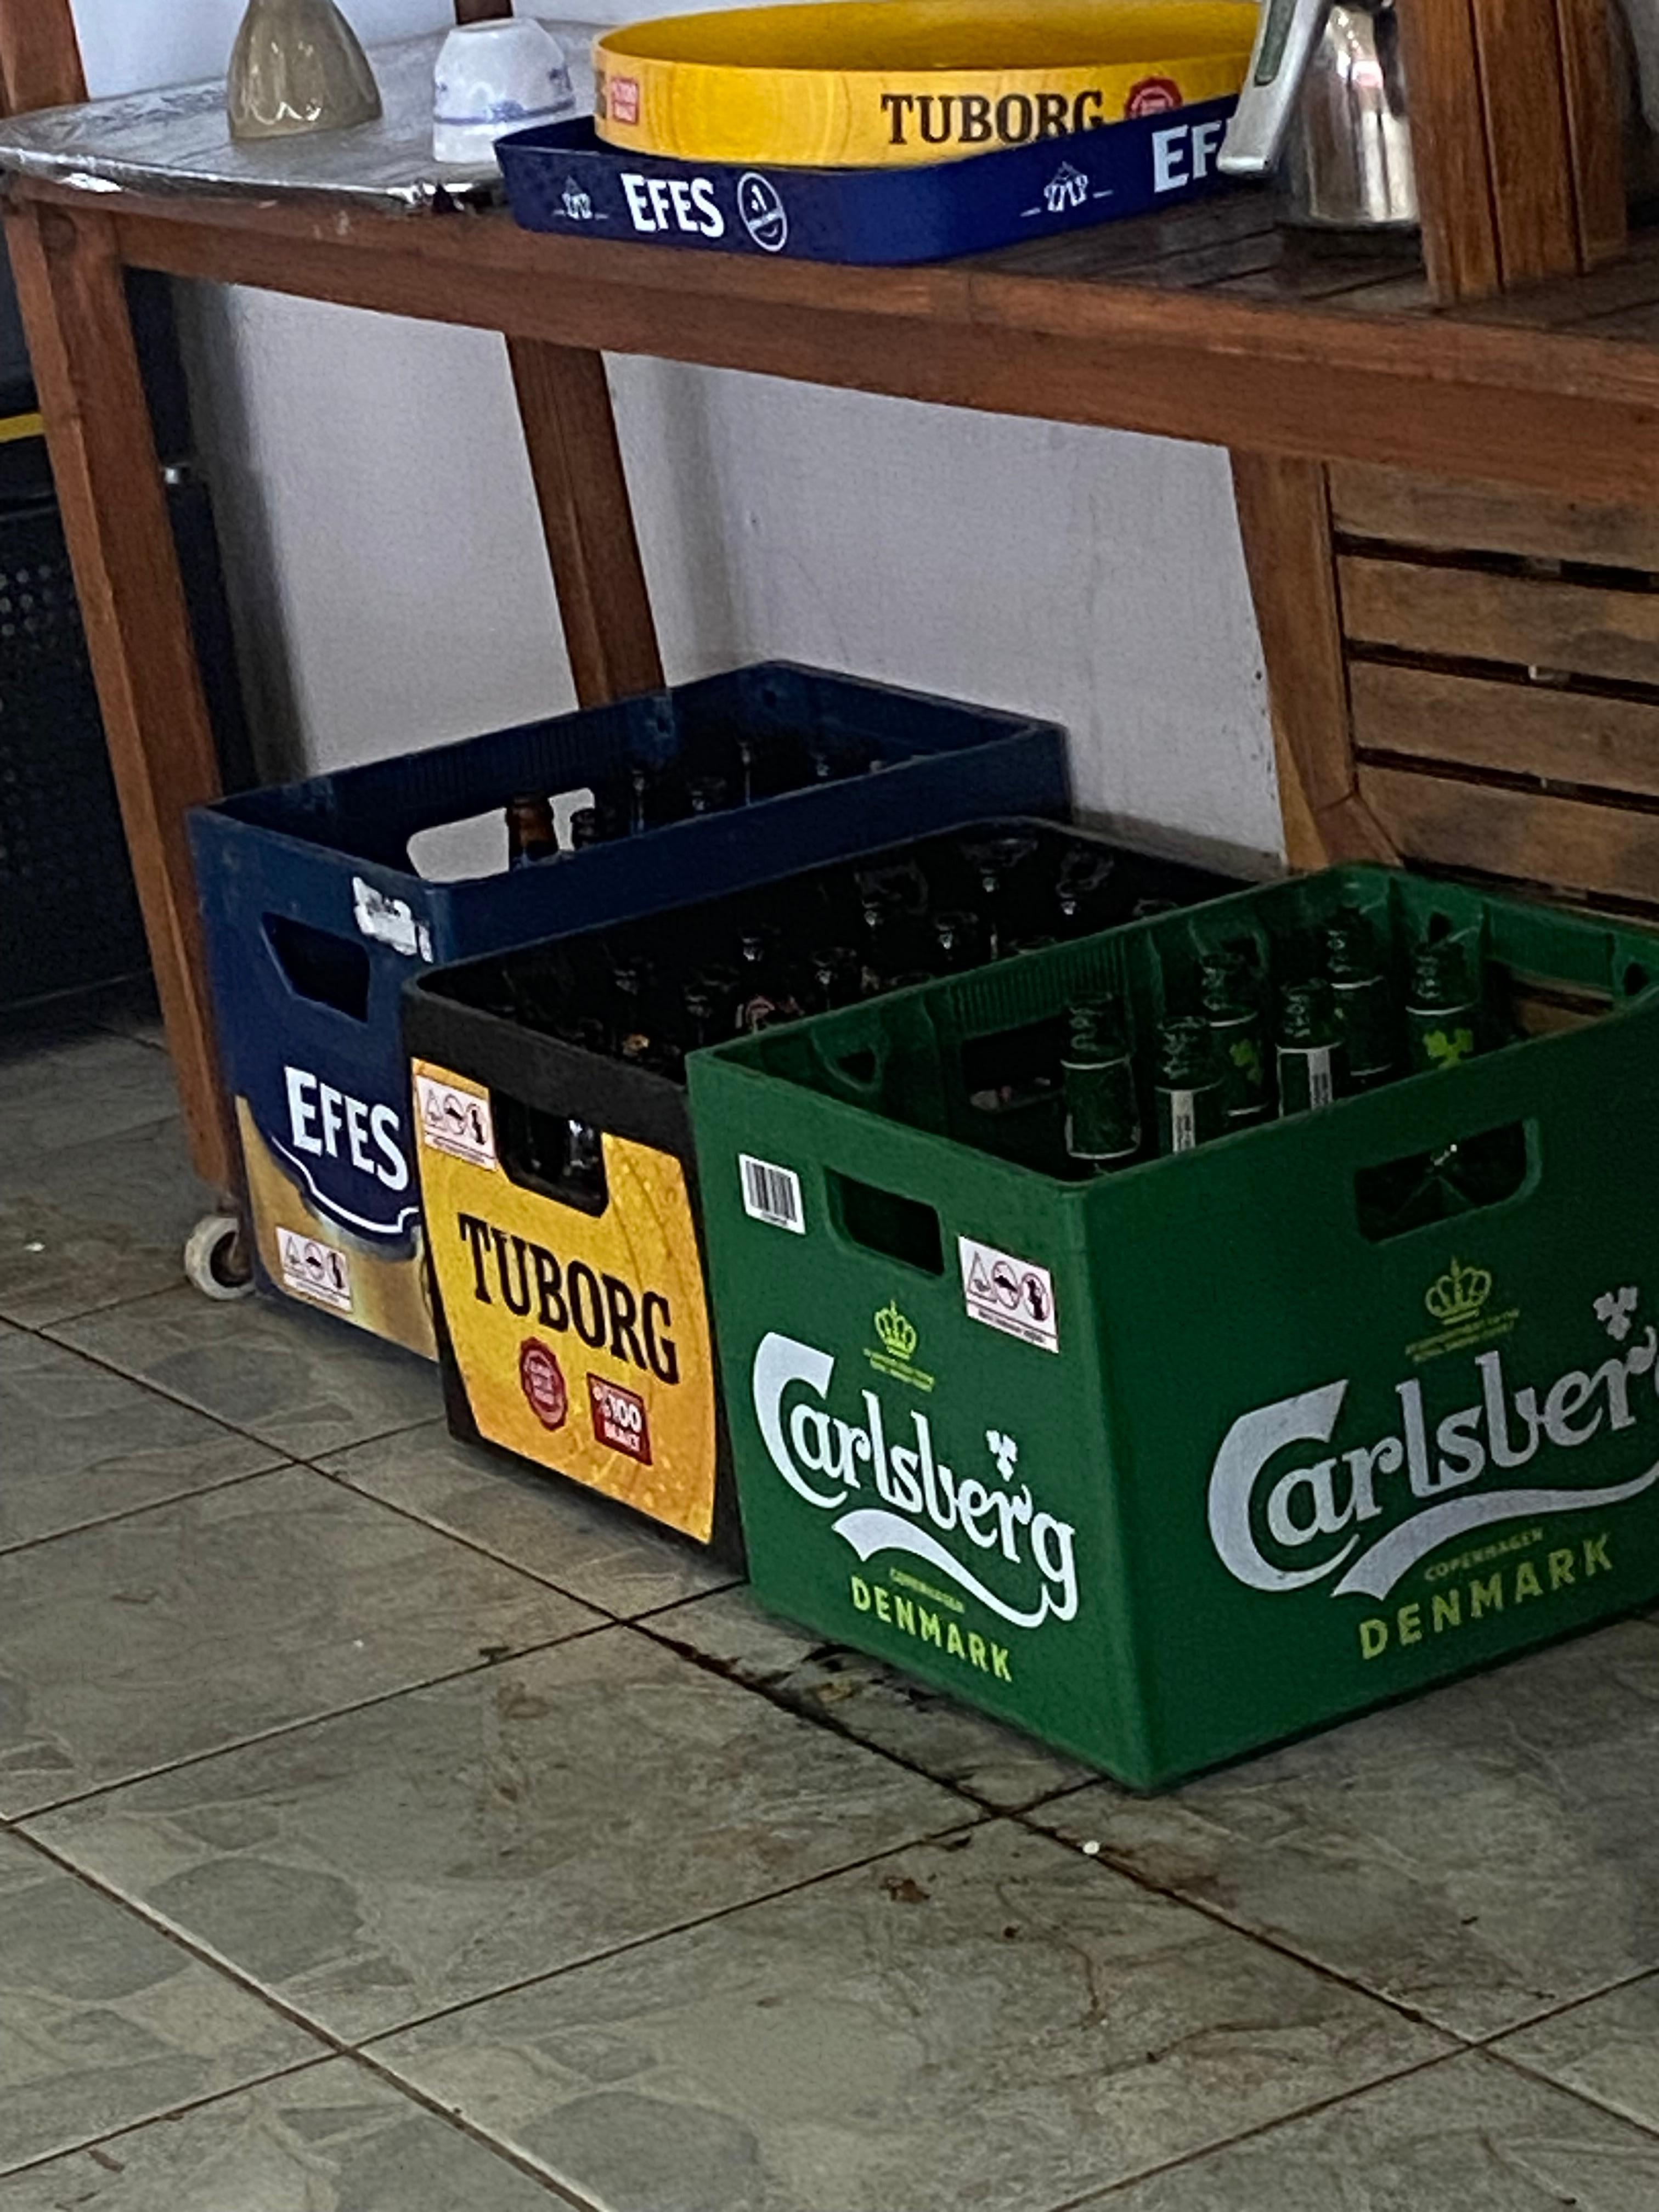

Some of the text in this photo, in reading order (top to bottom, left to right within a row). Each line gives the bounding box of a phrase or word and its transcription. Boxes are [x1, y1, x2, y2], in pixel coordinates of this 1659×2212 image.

[881, 91, 1103, 144] TUBORG
[1152, 119, 1222, 193] EF
[620, 172, 724, 238] EFES
[284, 1065, 409, 1191] EFES
[458, 1211, 680, 1386] TUBORG
[753, 1331, 1079, 1628] Carlsberg
[1207, 1326, 1659, 1601] Carlsber
[851, 1575, 1013, 1683] DENMARK
[1358, 1533, 1614, 1661] DENMARK
